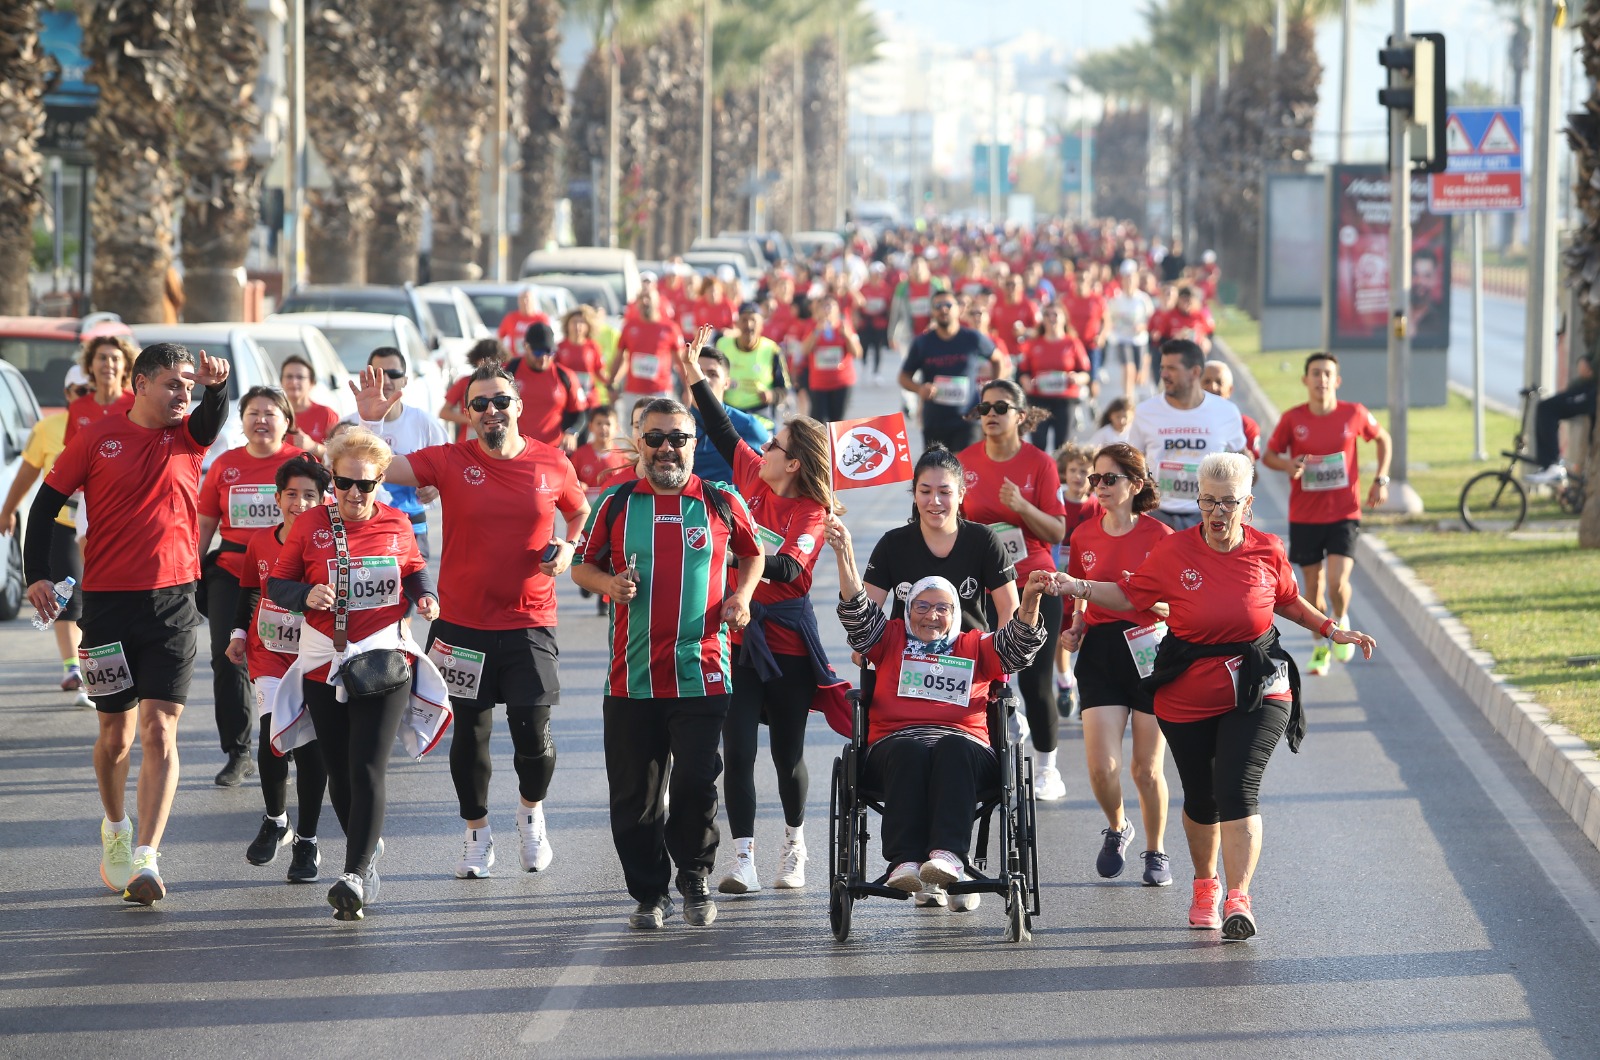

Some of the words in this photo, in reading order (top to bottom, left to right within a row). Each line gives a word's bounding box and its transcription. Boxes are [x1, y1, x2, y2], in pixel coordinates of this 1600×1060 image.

[1158, 427, 1211, 435] MERRELL
[896, 430, 909, 462] ATA
[1164, 438, 1206, 450] BOLD
[232, 504, 280, 517] 350315
[350, 579, 396, 598] 0549
[902, 670, 967, 695] 350554
